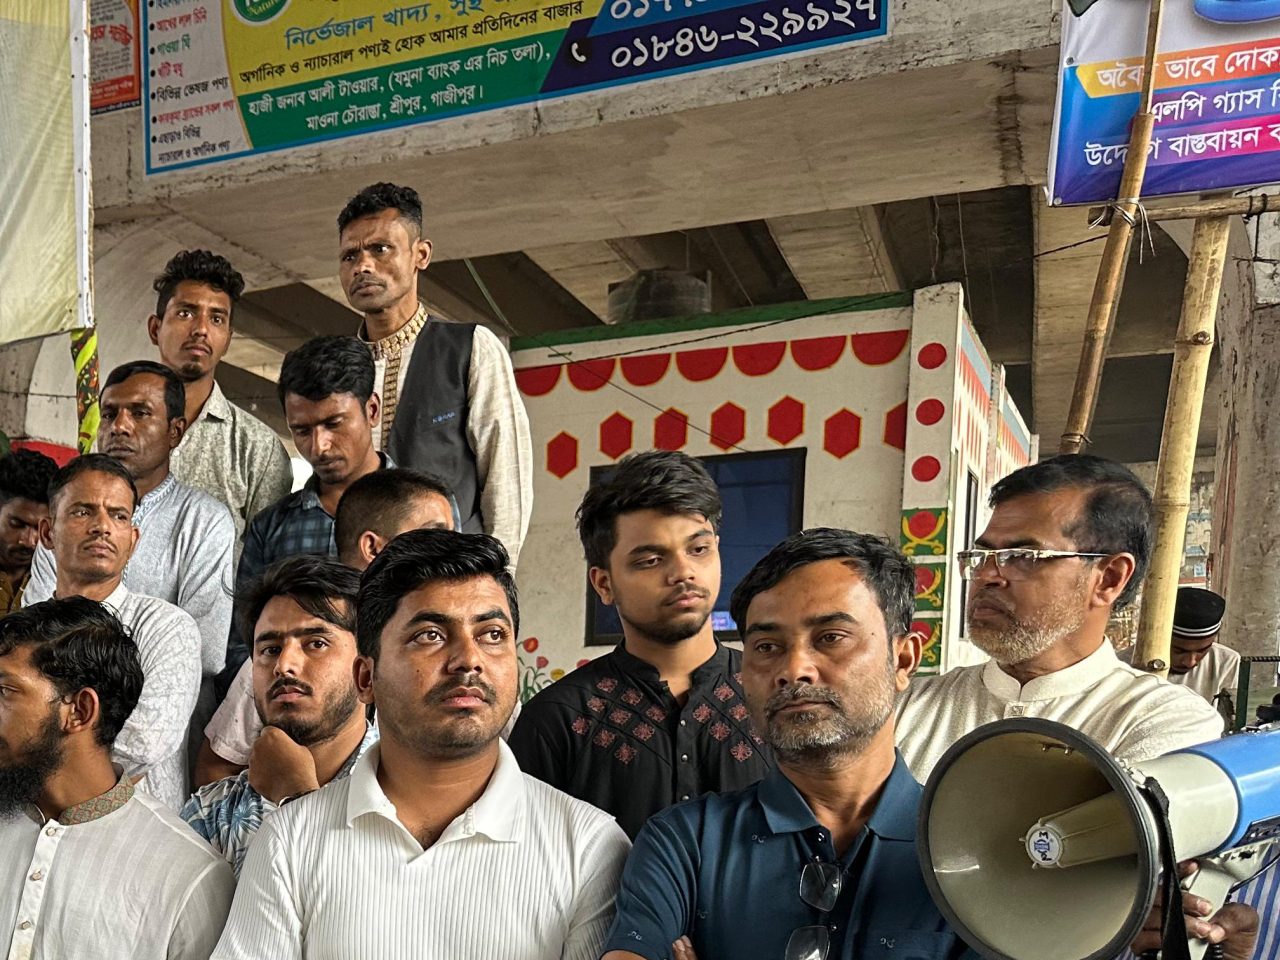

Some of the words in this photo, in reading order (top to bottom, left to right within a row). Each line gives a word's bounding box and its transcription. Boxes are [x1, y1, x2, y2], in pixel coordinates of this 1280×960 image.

[284, 16, 375, 50] নির্ভেজাল
[289, 63, 300, 74] ও
[303, 49, 353, 73] ন্যাচারাল
[358, 40, 391, 61] পণ্যই
[395, 33, 426, 51] হোক
[429, 24, 468, 45] আমার
[472, 9, 538, 36] প্রতিদিনের
[542, 1, 584, 20] বাজার
[248, 93, 274, 116] হাজী
[426, 58, 461, 80] ব্যাংক
[463, 54, 483, 70] এর
[486, 48, 509, 69] নিচ
[1096, 62, 1158, 88] অবৈ
[1164, 54, 1219, 80] ভাবে
[1224, 46, 1280, 73] দোক
[1213, 88, 1265, 114] গ্যাস
[305, 111, 339, 130] মাওনা
[1168, 126, 1263, 157] বাস্তবায়ন
